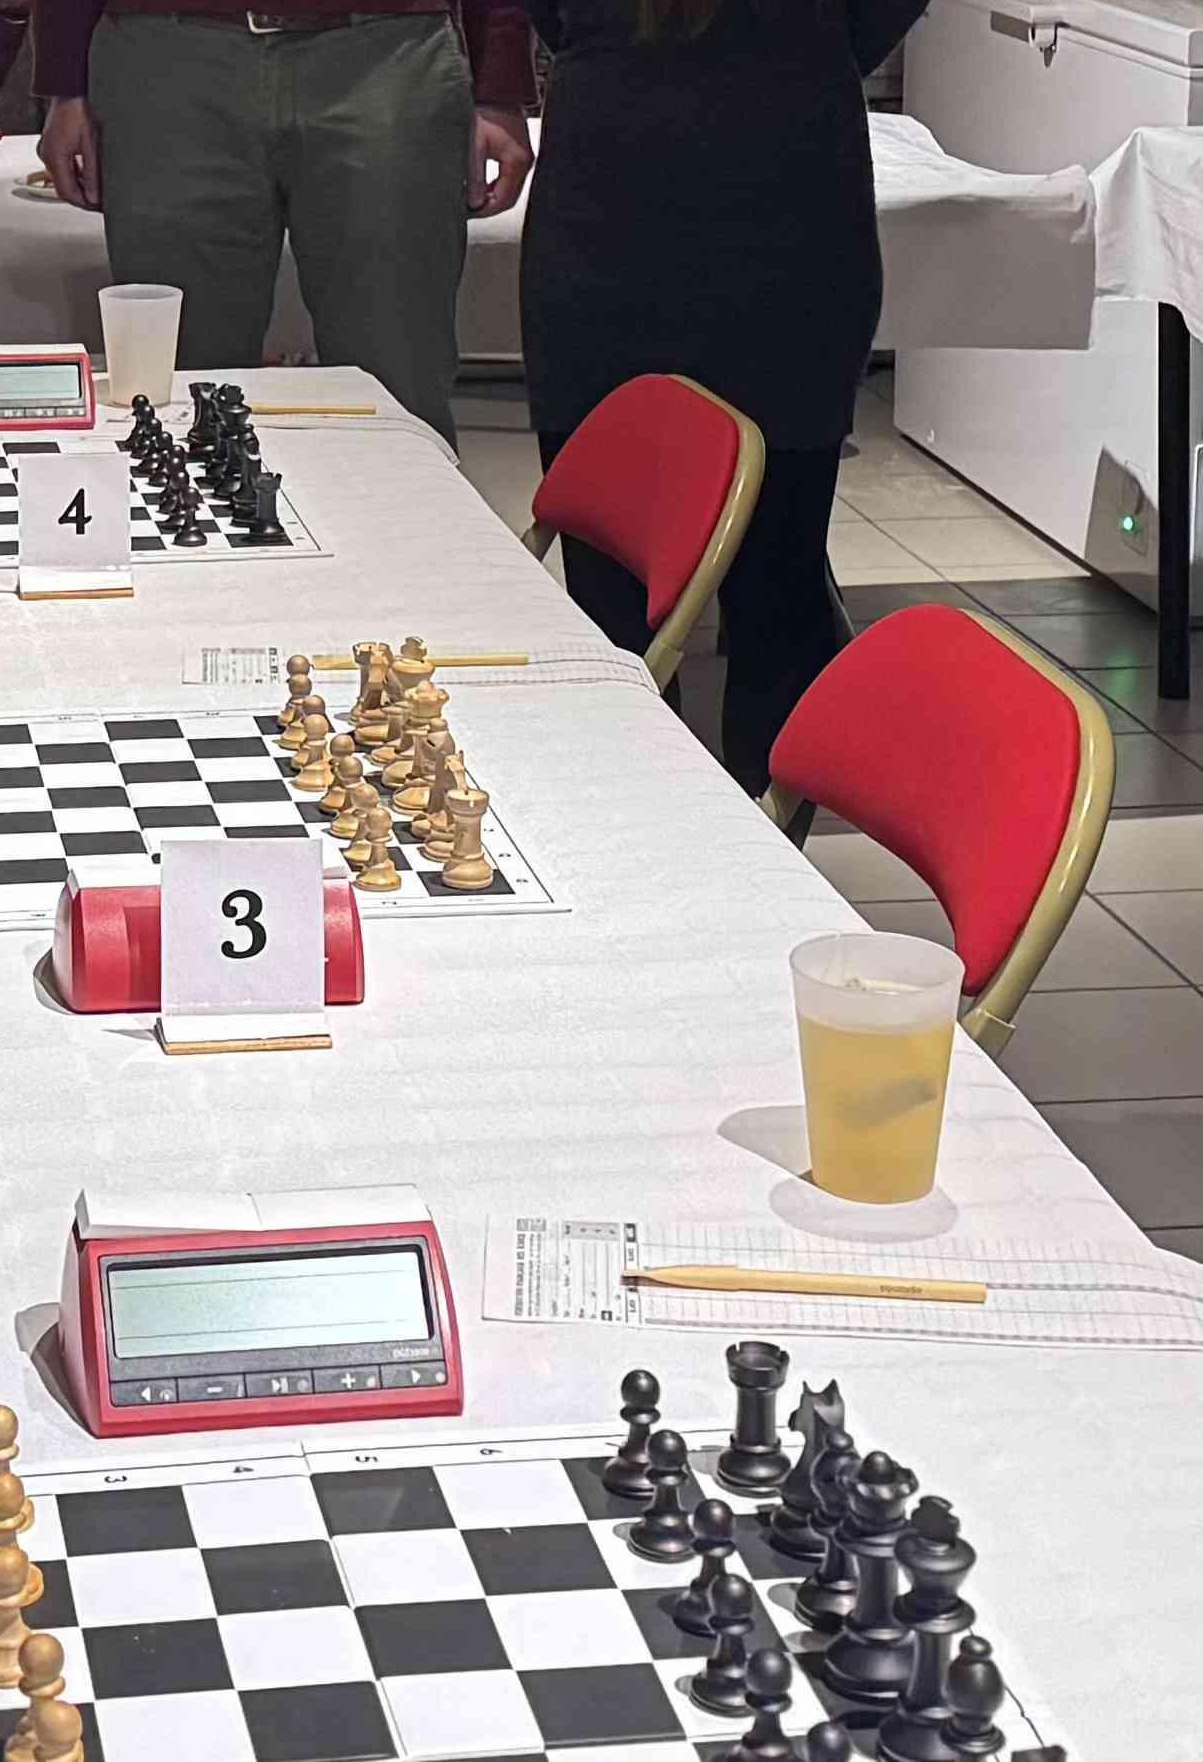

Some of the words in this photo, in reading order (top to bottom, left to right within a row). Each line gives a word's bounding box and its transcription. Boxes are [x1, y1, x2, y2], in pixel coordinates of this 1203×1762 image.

[58, 488, 92, 535] 4
[221, 889, 267, 959] 3
[104, 1475, 128, 1484] 3
